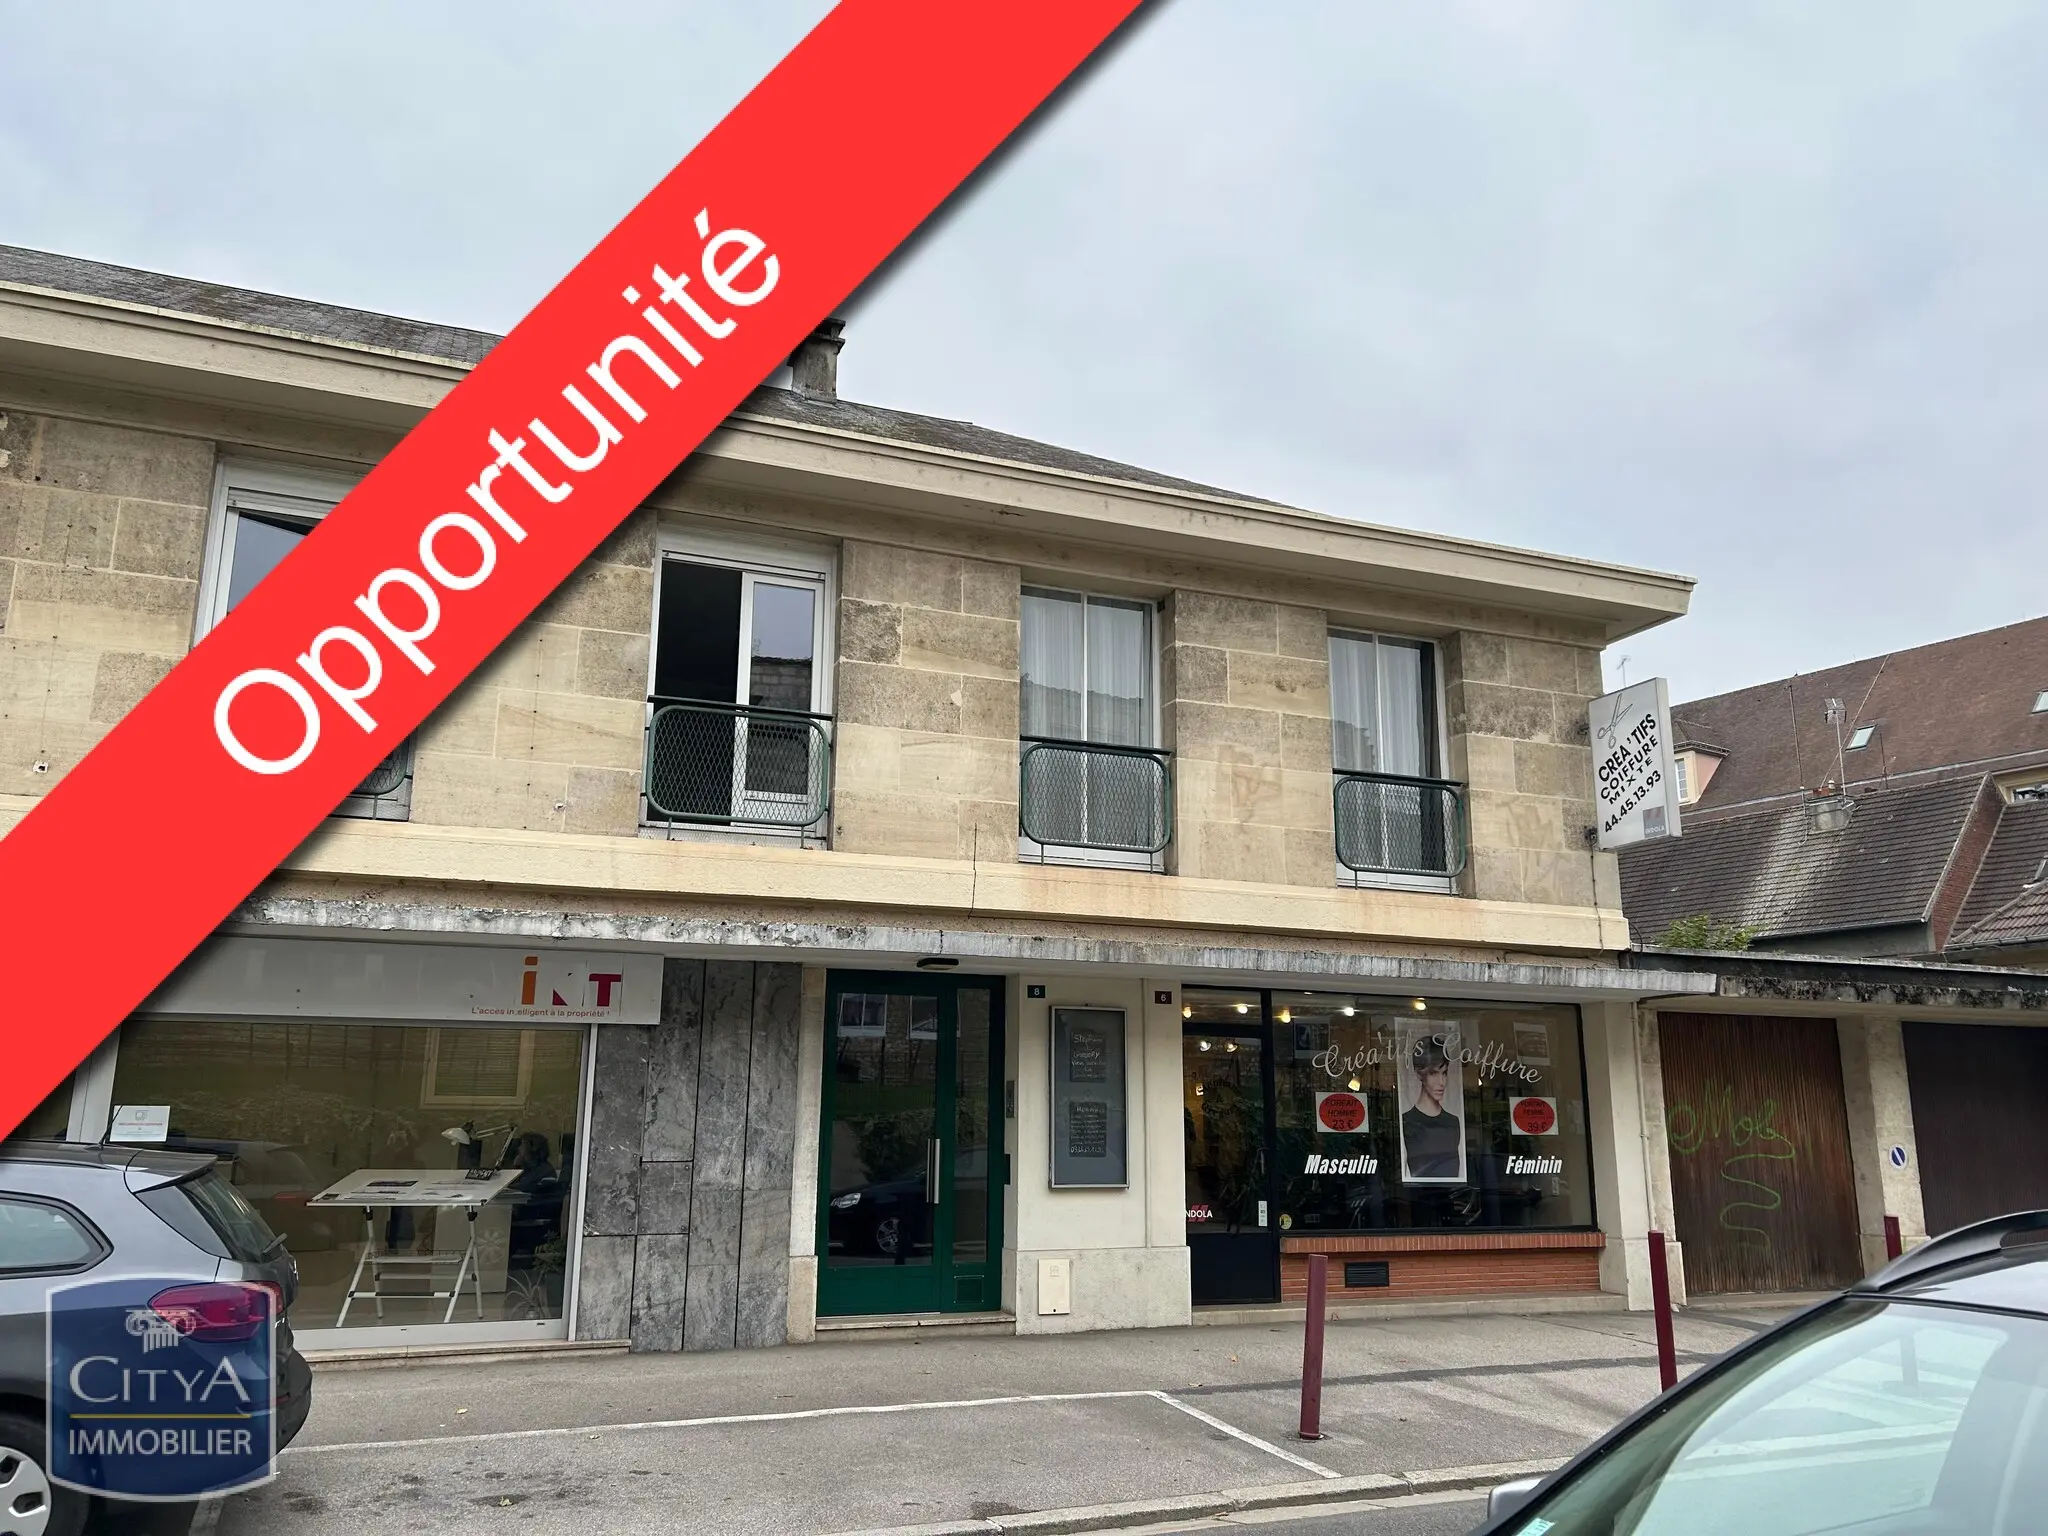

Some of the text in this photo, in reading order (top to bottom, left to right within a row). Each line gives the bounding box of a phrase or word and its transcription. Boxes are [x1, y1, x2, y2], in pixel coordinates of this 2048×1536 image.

[1601, 735, 1658, 799] COIFFURE
[1609, 757, 1652, 804] MIXTE
[1605, 770, 1661, 832] 44.45.13.93
[1033, 987, 1040, 996] 8
[1160, 993, 1167, 1002] 6
[506, 1008, 548, 1017] inelligent
[1432, 1032, 1543, 1083] Coiffure
[1331, 1120, 1345, 1129] 23
[1304, 1154, 1563, 1175] Masculin Féminin
[1185, 1210, 1213, 1218] NDOLA
